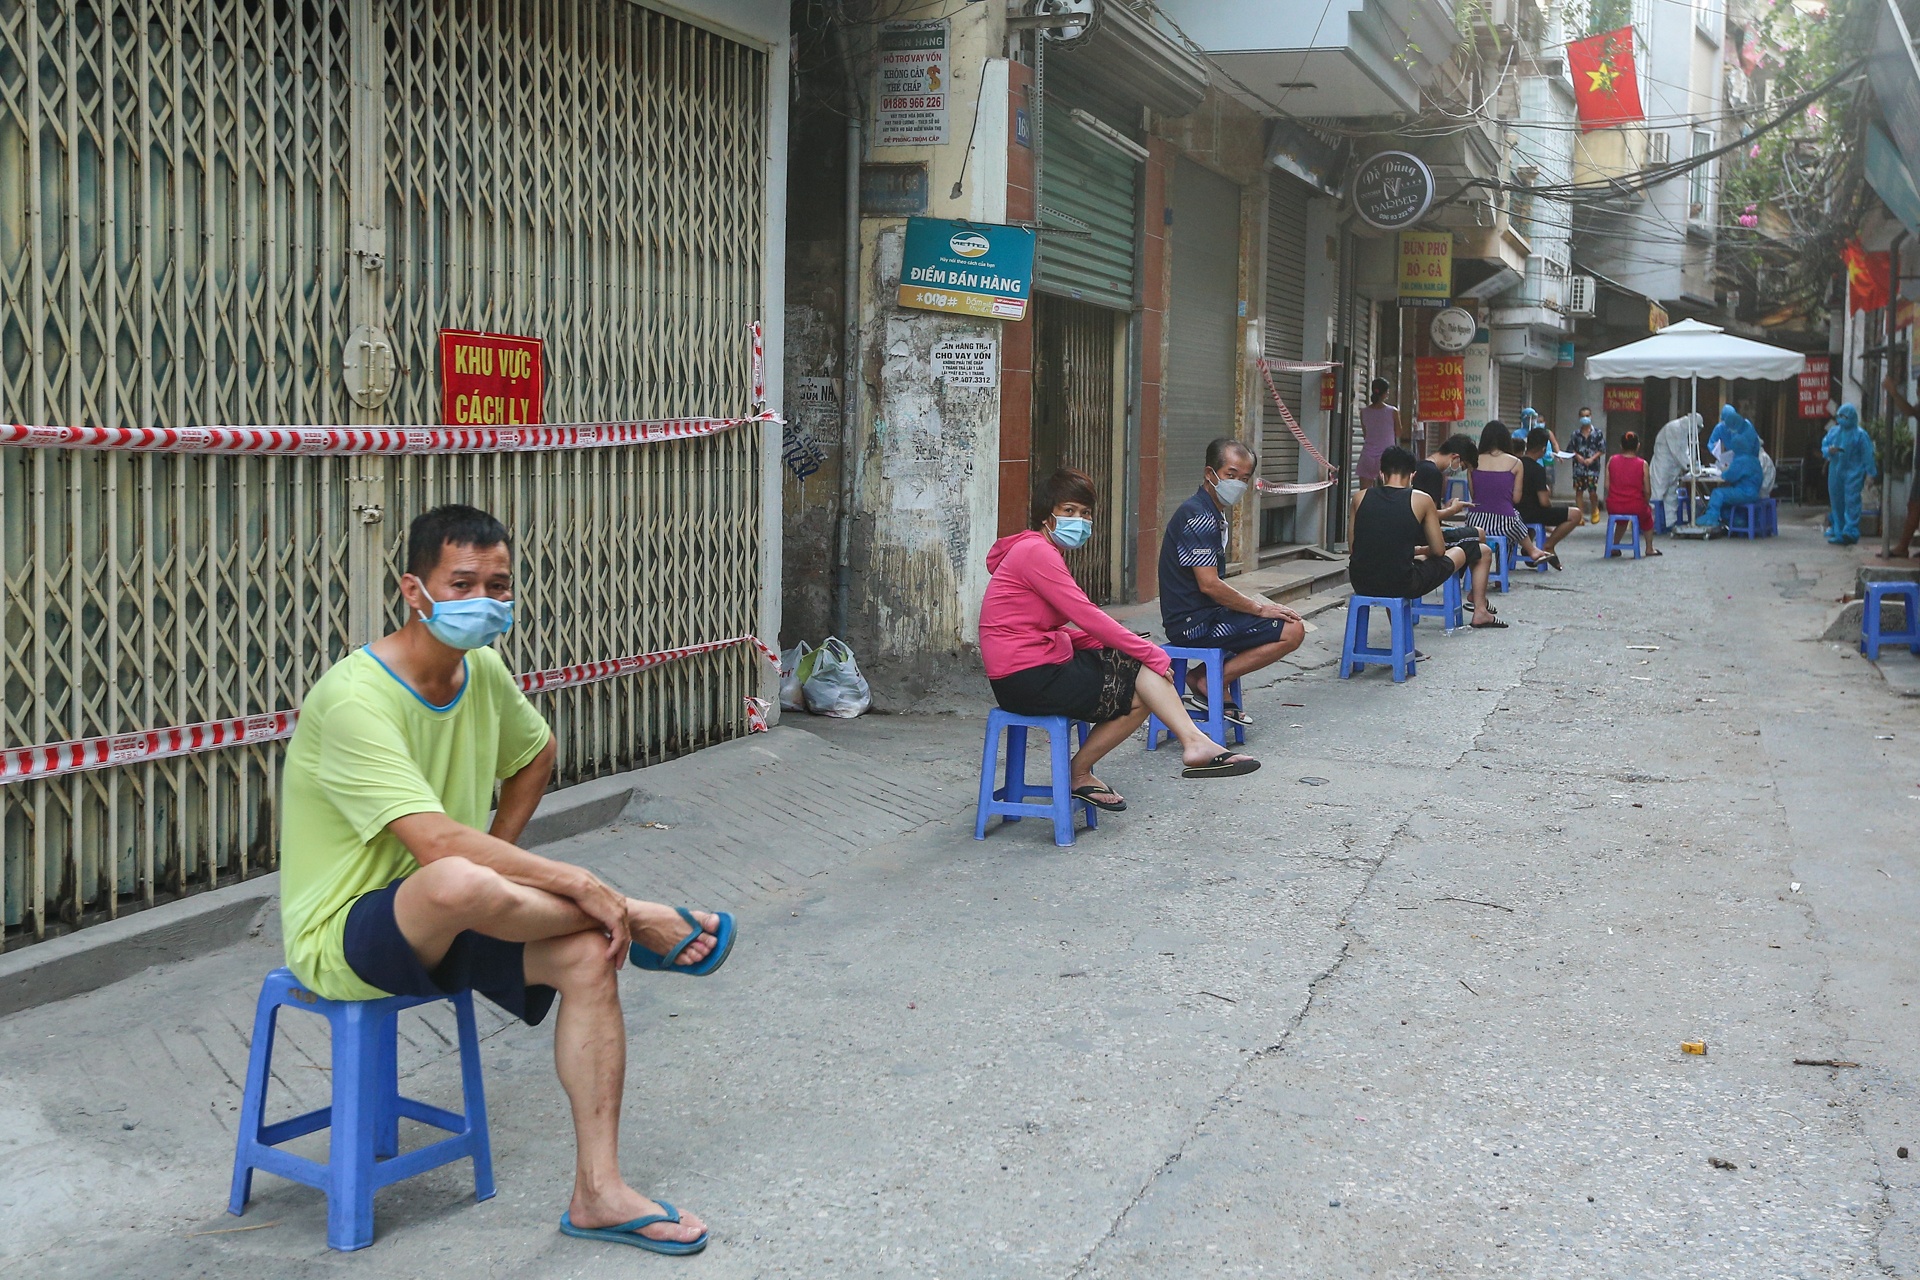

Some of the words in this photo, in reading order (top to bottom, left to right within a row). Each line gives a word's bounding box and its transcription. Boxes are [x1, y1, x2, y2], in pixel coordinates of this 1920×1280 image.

[911, 54, 925, 63] VAY
[926, 51, 942, 62] VỐN
[884, 67, 908, 79] KHÔNG
[887, 80, 901, 92] THẾ
[903, 80, 921, 92] CHẤP
[910, 97, 924, 108] 966
[926, 96, 941, 108] 226
[1371, 195, 1418, 213] BARBER
[1427, 237, 1448, 256] PHỞ
[1428, 259, 1442, 277] GÀ
[911, 264, 945, 283] ĐIỂM
[948, 271, 978, 289] BÁN
[980, 274, 1021, 293] HÀNG
[974, 350, 991, 360] VỐN
[455, 345, 493, 378] KHU
[498, 348, 531, 384] VỰC
[1437, 362, 1462, 376] 30k
[1440, 388, 1462, 401] 499k
[455, 390, 504, 424] CÁCH
[509, 395, 530, 426] LY
